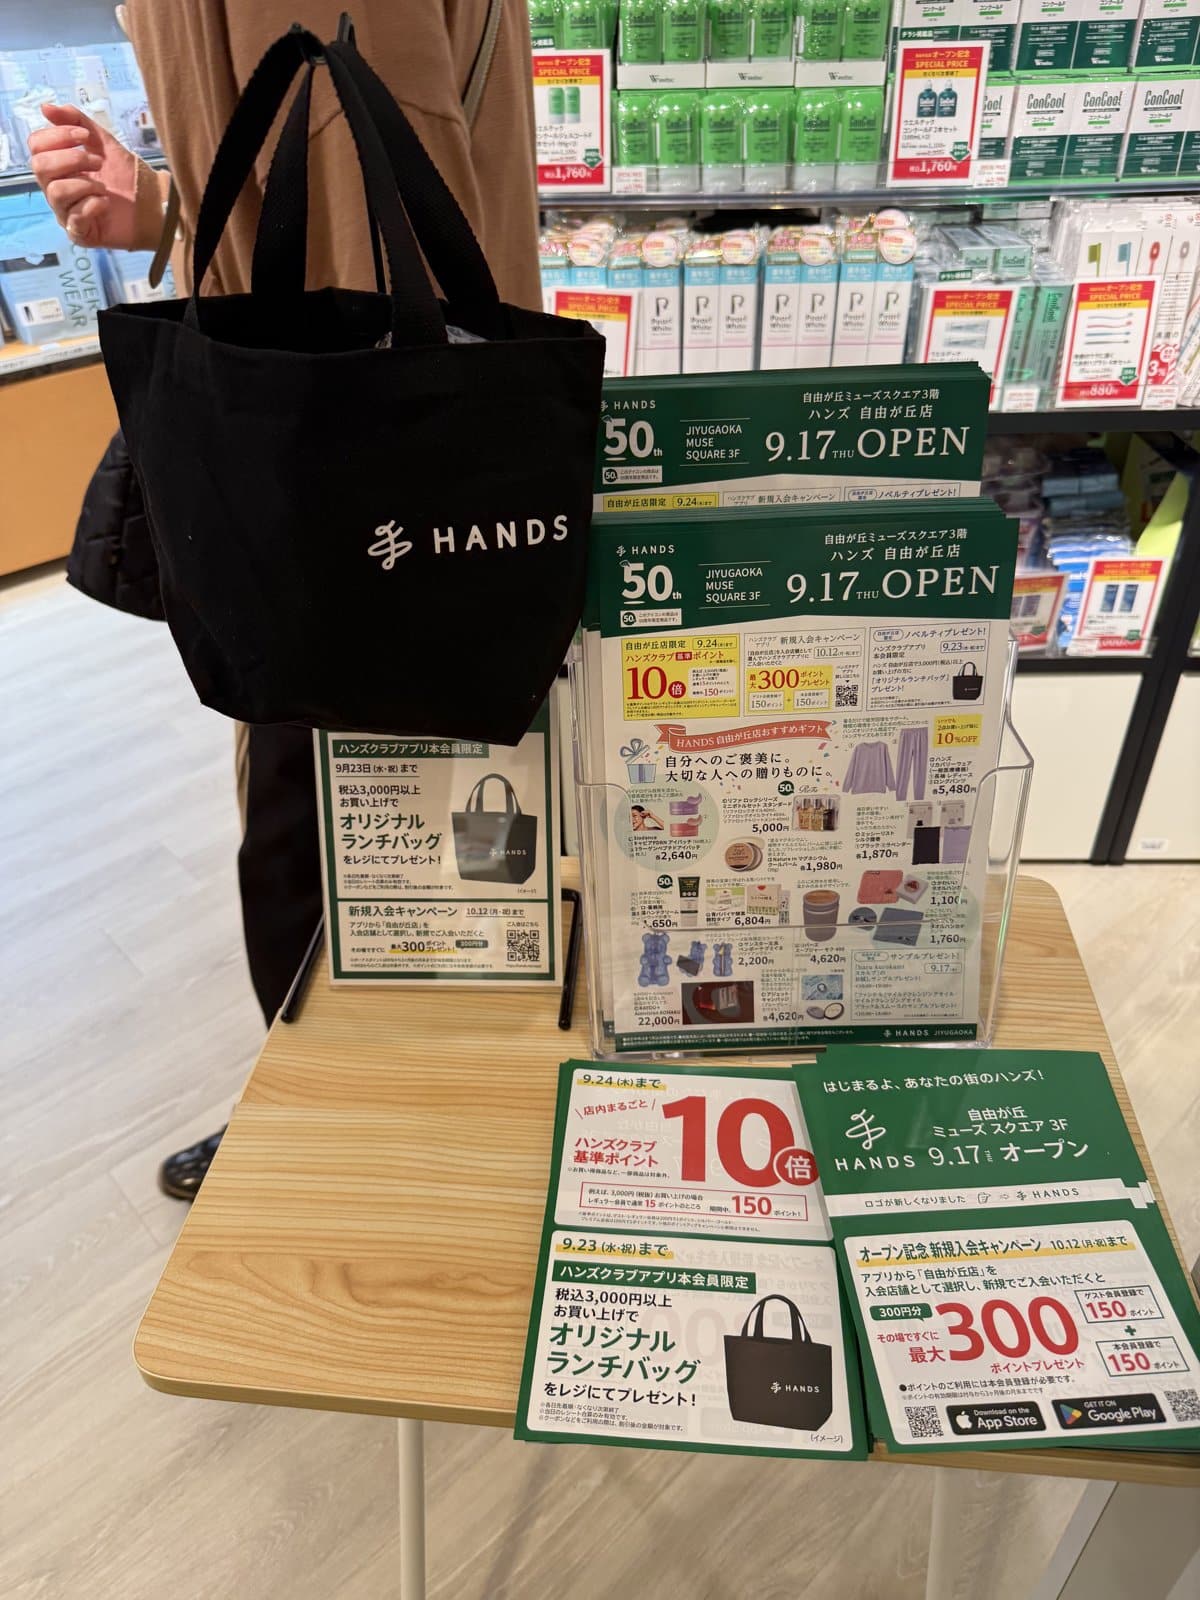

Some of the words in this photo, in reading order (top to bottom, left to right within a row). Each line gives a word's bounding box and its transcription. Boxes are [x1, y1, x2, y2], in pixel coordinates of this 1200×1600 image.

[1027, 93, 1066, 109] ConCool
[1083, 91, 1122, 107] ConCool
[1144, 89, 1184, 105] ConCool
[803, 389, 940, 404] 自由が丘ミューズスクエア3階
[614, 400, 657, 410] HANDS
[809, 407, 849, 420] ハンズ
[860, 405, 934, 419] 自由が丘店
[686, 424, 742, 436] JIYUGAOKA
[686, 437, 714, 448] MUSE
[765, 430, 836, 462] 9.17
[832, 449, 854, 459] THU
[856, 426, 971, 459] OPEN
[686, 449, 725, 461] SQUARE
[728, 448, 741, 459] 3F
[607, 497, 667, 508] 自由が丘店限定
[758, 492, 835, 503] 新規入会キャンペーン
[433, 514, 568, 554] HANDS
[824, 528, 968, 545] 自由が丘ミューズスクエア3階
[632, 545, 675, 555] HANDS
[830, 547, 874, 561] ハンズ
[884, 544, 961, 560] 自由が丘店
[706, 568, 763, 579] JIYUGAOKA
[706, 581, 734, 590] MUSE
[786, 571, 860, 603] 9.17
[856, 591, 879, 599] THU
[882, 565, 1000, 599] OPEN
[706, 592, 746, 604] SQUARE
[748, 591, 761, 600] 3F
[625, 641, 686, 650] 自由が丘店限定
[780, 635, 860, 644] 新規入会キャンペーン
[873, 644, 926, 652] ハンズクラブアプリ
[626, 653, 674, 662] ハンズクラブ
[693, 650, 724, 659] ポイント
[626, 666, 668, 699] 10
[671, 684, 682, 695] 倍
[758, 669, 800, 689] 300
[704, 688, 718, 696] 150
[676, 737, 714, 748] HANDS
[716, 725, 823, 744] 自由が丘店おすすめギフト
[937, 733, 978, 745] 10%OFF
[339, 743, 484, 755] ハンズクラブアプリ本会員限定
[666, 753, 790, 768] 自分へのご褒美に。
[665, 766, 832, 783] 大切な人への贈りものに。
[338, 785, 420, 796] 税込3,000円以上
[340, 798, 398, 807] お買い上げで
[340, 813, 425, 830] オリジナル
[752, 823, 789, 834] 5,000円
[341, 833, 442, 849] ランチバッグ
[344, 855, 441, 865] をレジにてプレゼント!
[349, 906, 458, 917] 新規入会キャンペーン
[734, 916, 771, 926] 6,804円
[402, 941, 425, 952] 300
[930, 934, 966, 944] 1,760円
[738, 956, 774, 965] 2,200円
[810, 954, 846, 964] 4,620円
[638, 1016, 681, 1027] 22,000円
[823, 1069, 1045, 1093] はじまるよ、あなたの街のハンズ!
[583, 1099, 648, 1116] 店内まるごと
[968, 1106, 1028, 1121] 自由が丘
[932, 1122, 987, 1138] ミューズ
[993, 1120, 1044, 1135] スクエア
[1050, 1119, 1068, 1132] 3F
[575, 1137, 657, 1151] ハンズクラブ
[662, 1096, 794, 1188] 10
[784, 1156, 812, 1180] 倍
[573, 1151, 658, 1167] 基準ポイント
[928, 1144, 980, 1167] 9.17
[998, 1139, 1088, 1163] オープン
[835, 1155, 916, 1171] HANDS
[865, 1194, 966, 1208] ロゴが新しくなりました
[1032, 1187, 1079, 1200] HANDS
[645, 1199, 656, 1208] 15
[658, 1202, 701, 1210] ポイントのところ
[731, 1195, 772, 1216] 150
[860, 1243, 929, 1262] オープン記念
[929, 1238, 1041, 1259] 新規入会キャンペーン
[560, 1265, 749, 1289] ハンズクラブアプリ本会員限定
[861, 1266, 997, 1283] アプリから「自由が丘店」を
[865, 1273, 1106, 1298] 入会店舗として選択し、新規でご入会いただくと
[555, 1287, 672, 1308] 税込3,000円以上
[1084, 1288, 1145, 1300] ゲスト会員登録で
[554, 1304, 639, 1323] お買い上げで
[879, 1305, 923, 1318] 300円分
[1085, 1301, 1127, 1320] 150
[1130, 1307, 1156, 1317] ポイント
[550, 1322, 676, 1353] オリジナル
[876, 1330, 940, 1344] その場ですぐに
[909, 1345, 946, 1364] 最大
[934, 1296, 1080, 1362] 300
[1112, 1340, 1161, 1351] 本会員登録で
[547, 1350, 701, 1384] ランチバッグ
[990, 1358, 1085, 1375] ポイントプレゼント
[1107, 1352, 1151, 1373] 150
[1154, 1359, 1179, 1370] ポイント
[544, 1381, 696, 1406] をレジにてプレゼント!
[786, 1384, 820, 1393] HANDS
[1083, 1400, 1098, 1408] GET
[1105, 1399, 1117, 1407] ON
[973, 1407, 1006, 1417] Download
[1018, 1406, 1030, 1414] the
[1088, 1407, 1130, 1422] Google
[1131, 1406, 1157, 1421] Play
[977, 1416, 1002, 1429] App
[1003, 1414, 1038, 1427] Store
